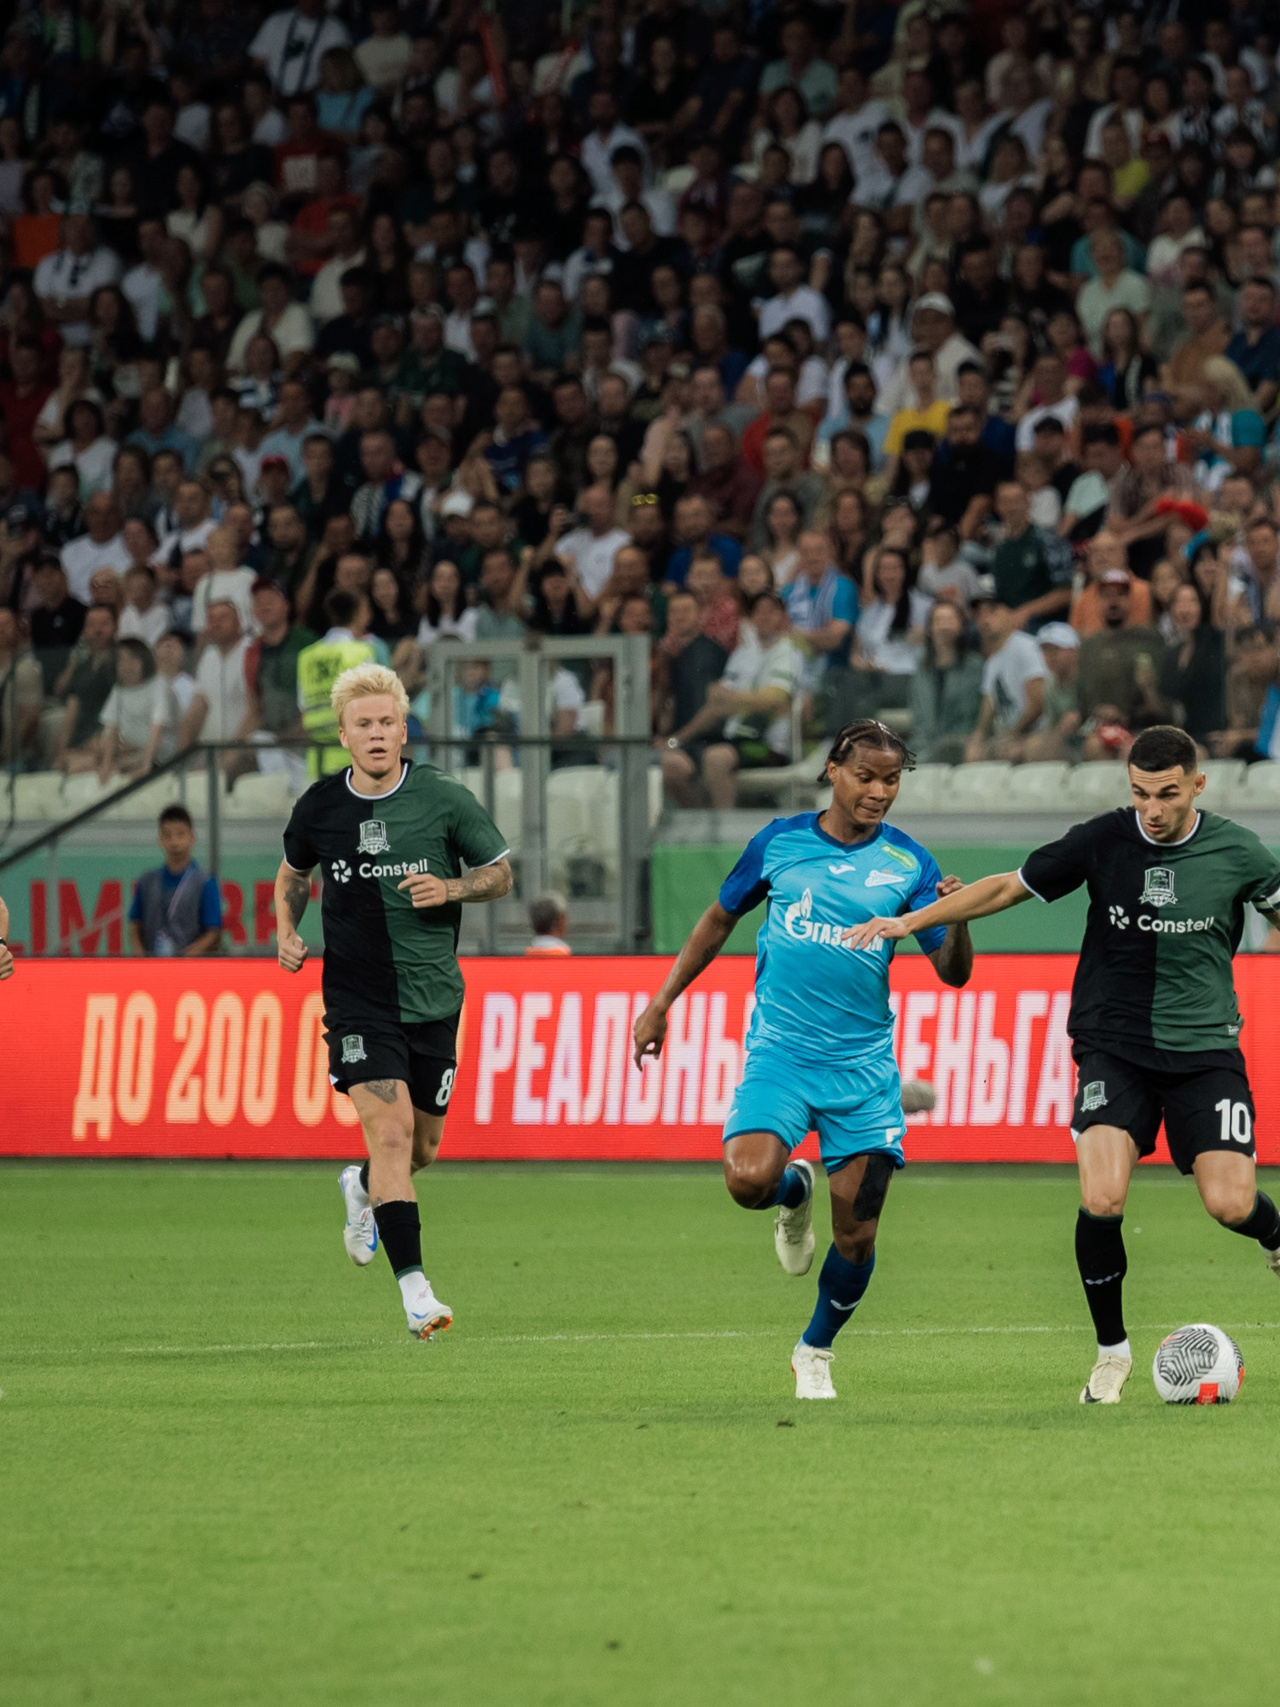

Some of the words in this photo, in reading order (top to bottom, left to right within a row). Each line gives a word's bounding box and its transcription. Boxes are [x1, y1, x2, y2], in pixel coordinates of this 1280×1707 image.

[358, 858, 429, 879] Constell
[1137, 916, 1215, 934] Constell
[71, 992, 158, 1142] ДО
[164, 989, 284, 1127] 200
[474, 991, 753, 1126] РЕАЛЬНЫ
[435, 1067, 458, 1107] 8
[1214, 1098, 1252, 1144] 10
